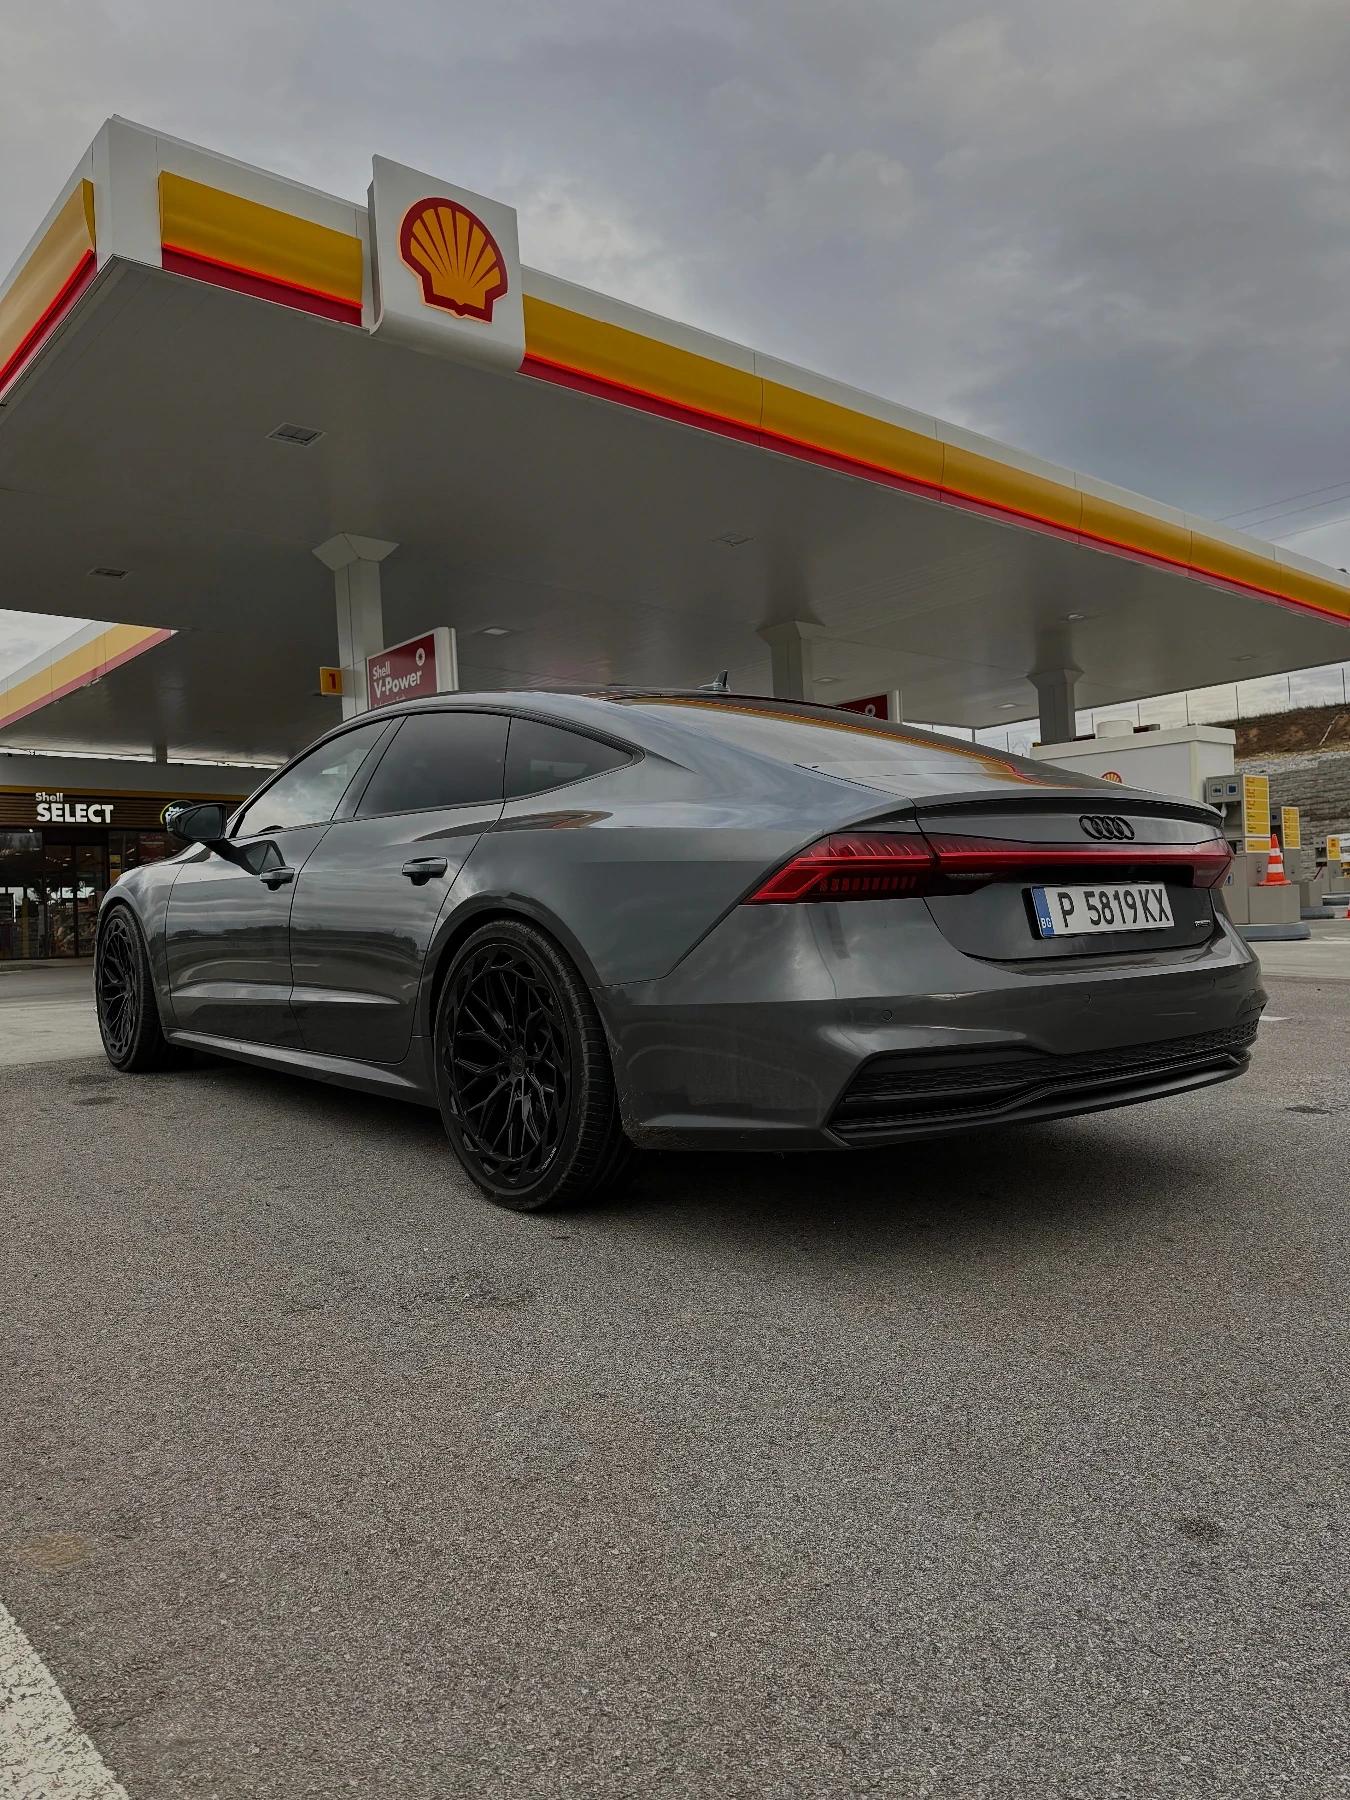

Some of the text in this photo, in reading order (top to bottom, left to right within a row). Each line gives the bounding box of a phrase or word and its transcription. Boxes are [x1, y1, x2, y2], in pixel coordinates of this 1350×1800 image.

[373, 661, 391, 679] Shell
[329, 673, 337, 690] 1
[374, 670, 422, 698] V-Power
[35, 792, 63, 802] Shell
[36, 803, 114, 823] SELECT
[1040, 917, 1052, 928] BG
